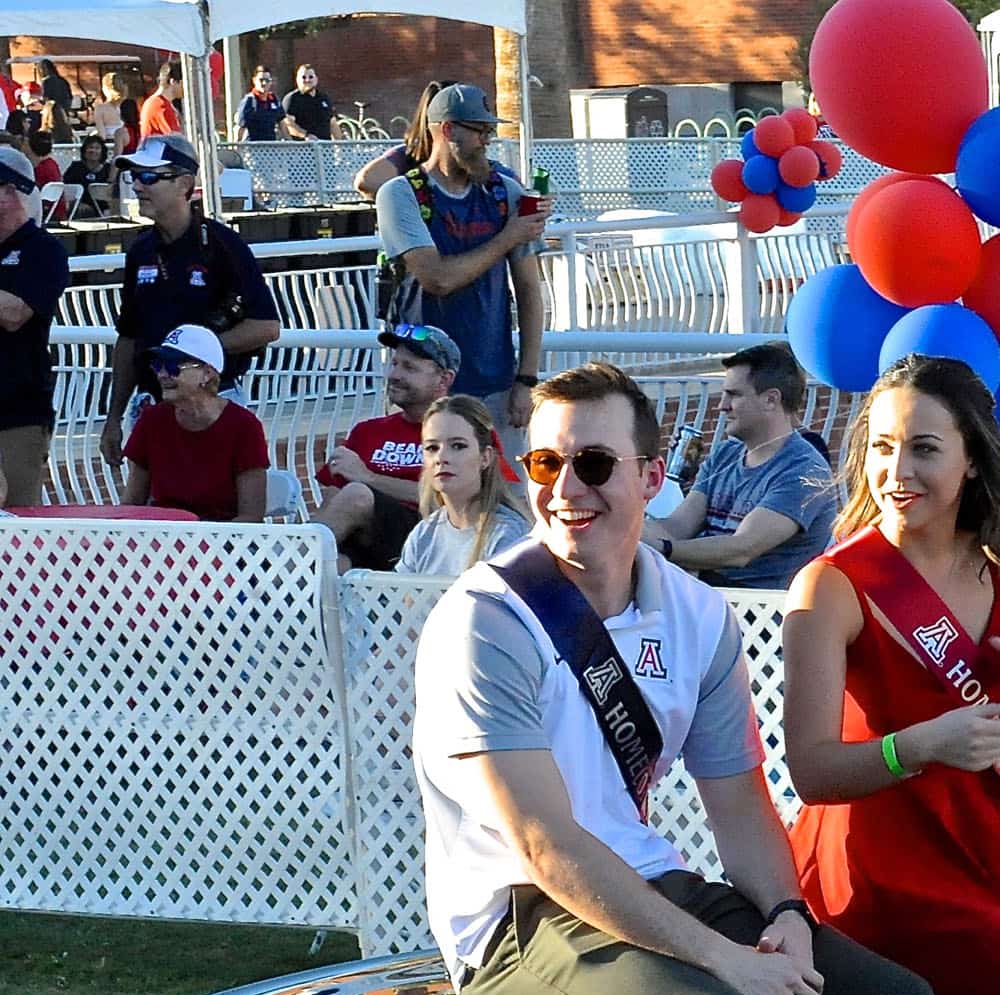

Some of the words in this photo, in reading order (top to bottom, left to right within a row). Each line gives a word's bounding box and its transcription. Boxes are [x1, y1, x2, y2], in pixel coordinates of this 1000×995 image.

[635, 638, 667, 680] A
[913, 616, 959, 664] A
[583, 657, 623, 705] A
